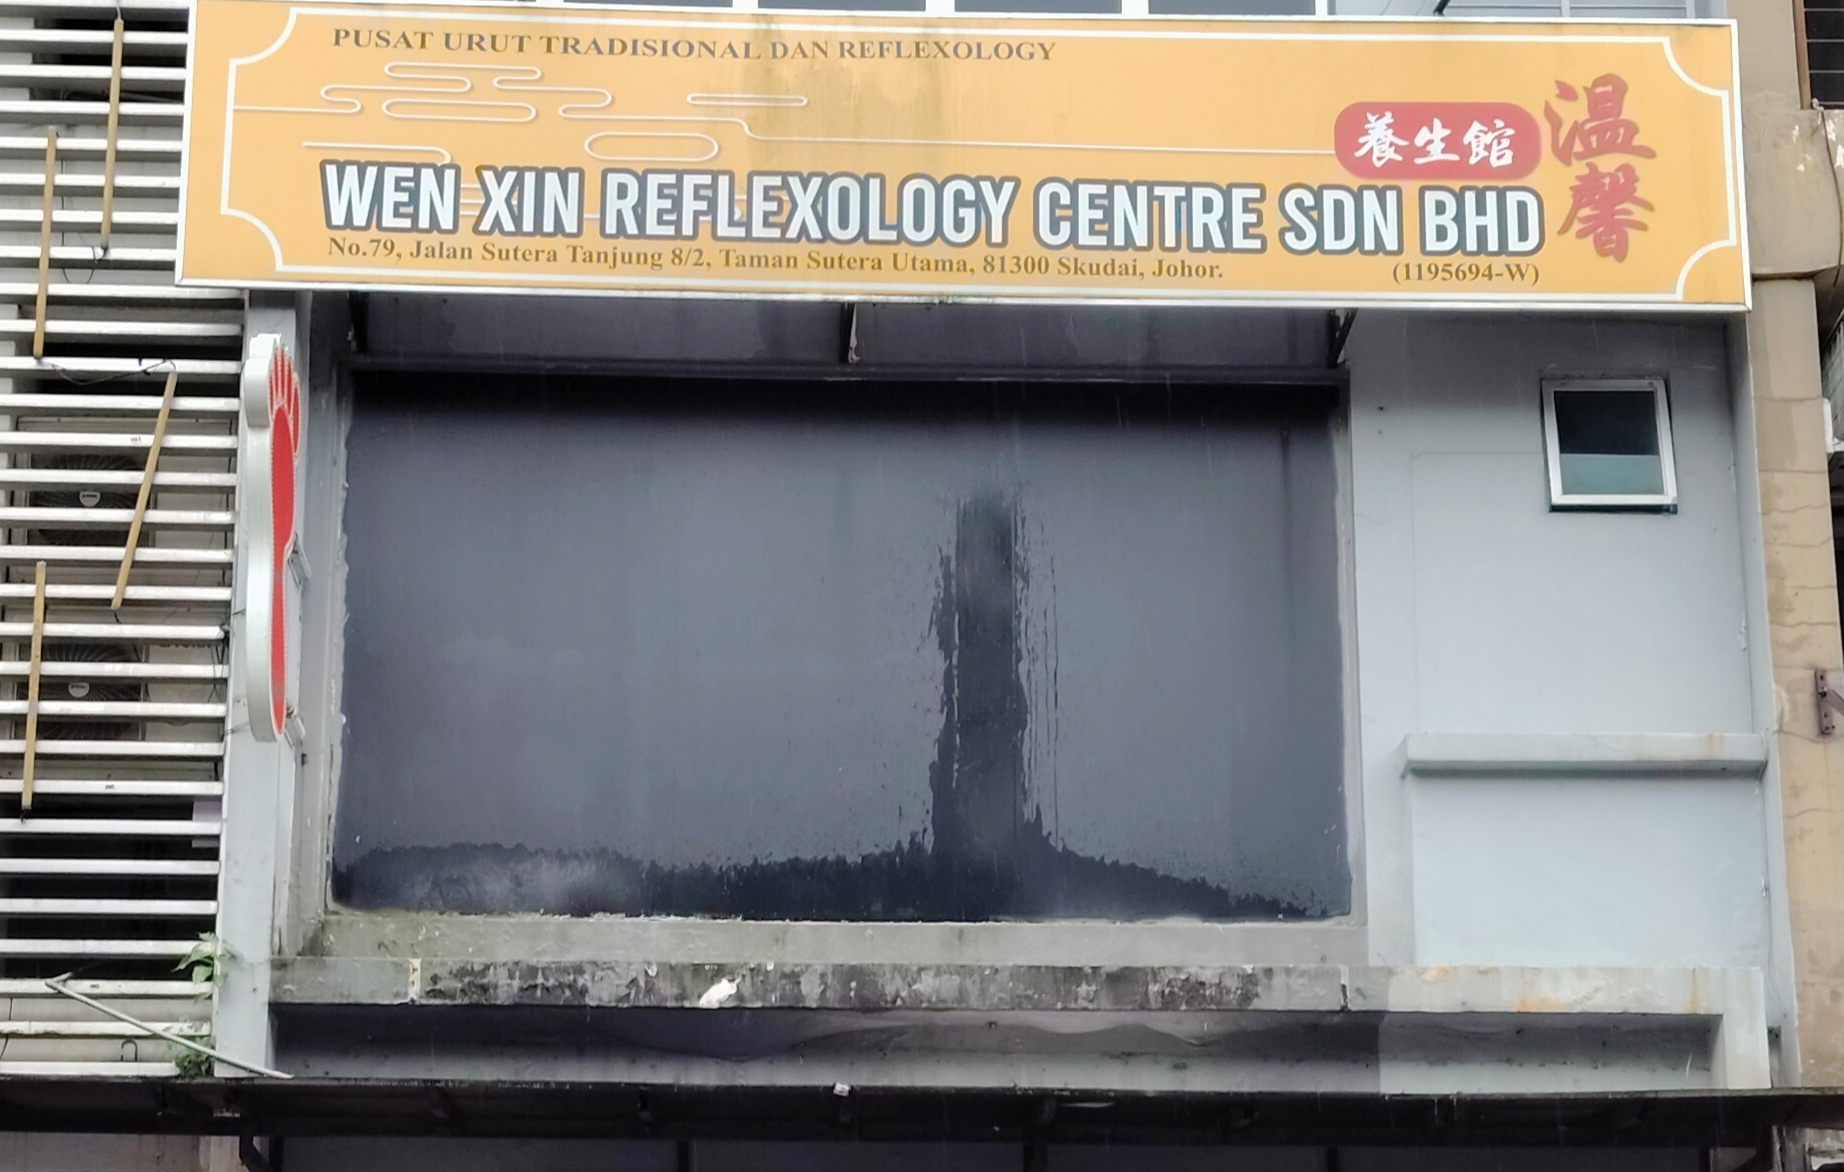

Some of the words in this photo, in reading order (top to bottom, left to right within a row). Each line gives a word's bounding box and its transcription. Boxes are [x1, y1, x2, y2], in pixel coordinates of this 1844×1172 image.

[333, 28, 433, 50] PUSAT
[443, 31, 531, 53] URUT
[539, 35, 761, 59] TRADISIONAL
[770, 41, 829, 60] DAN
[837, 40, 1056, 60] REFLEXOLOGY
[1354, 111, 1516, 168] 養生館
[322, 160, 460, 234] WEN
[473, 165, 584, 236] XIN
[600, 168, 1020, 247] REFLEXOLOGY
[1034, 177, 1267, 254] CENTRE
[1279, 184, 1403, 255] SDN
[1419, 185, 1545, 257] BHD
[328, 237, 402, 260] No.79,
[410, 240, 474, 260] Jalan
[481, 243, 558, 263] Sutera
[567, 245, 663, 270] Tanjung
[670, 247, 712, 270] 8/2,
[719, 248, 799, 269] Taman
[806, 250, 883, 271] Sutera
[892, 253, 976, 277] Utama,
[982, 255, 1050, 275] 81300
[1057, 256, 1145, 280] Skudai,
[1151, 258, 1223, 278] Johor.
[1392, 261, 1540, 286] (1195694-W)
